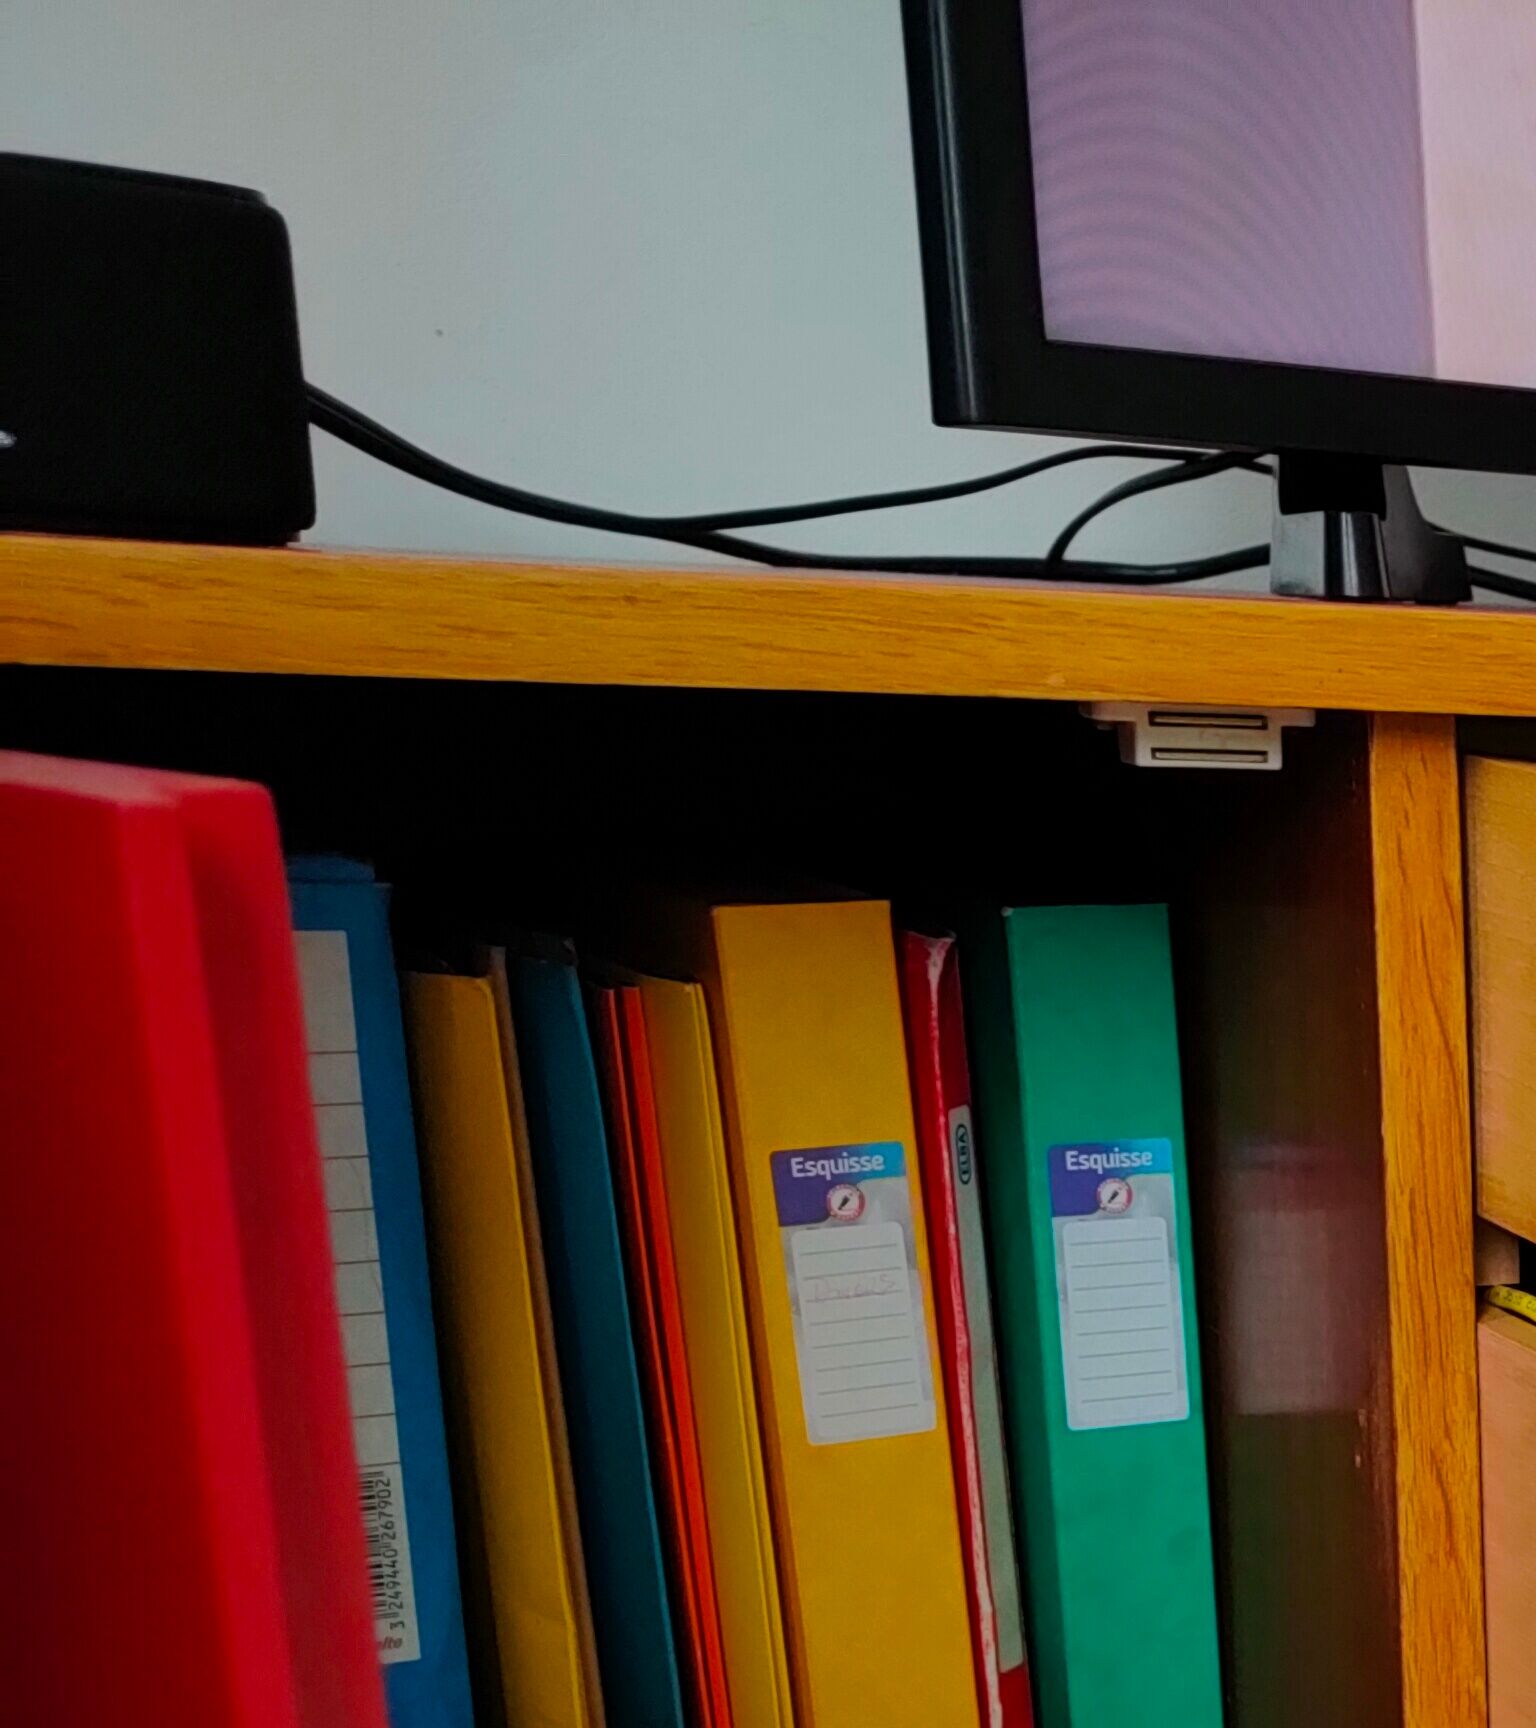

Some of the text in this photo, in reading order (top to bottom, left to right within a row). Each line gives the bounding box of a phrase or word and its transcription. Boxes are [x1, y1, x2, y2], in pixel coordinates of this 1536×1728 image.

[790, 1151, 885, 1181] Esquisse
[1065, 1147, 1153, 1175] Esquisse
[375, 1477, 405, 1631] 3 249440 267902
